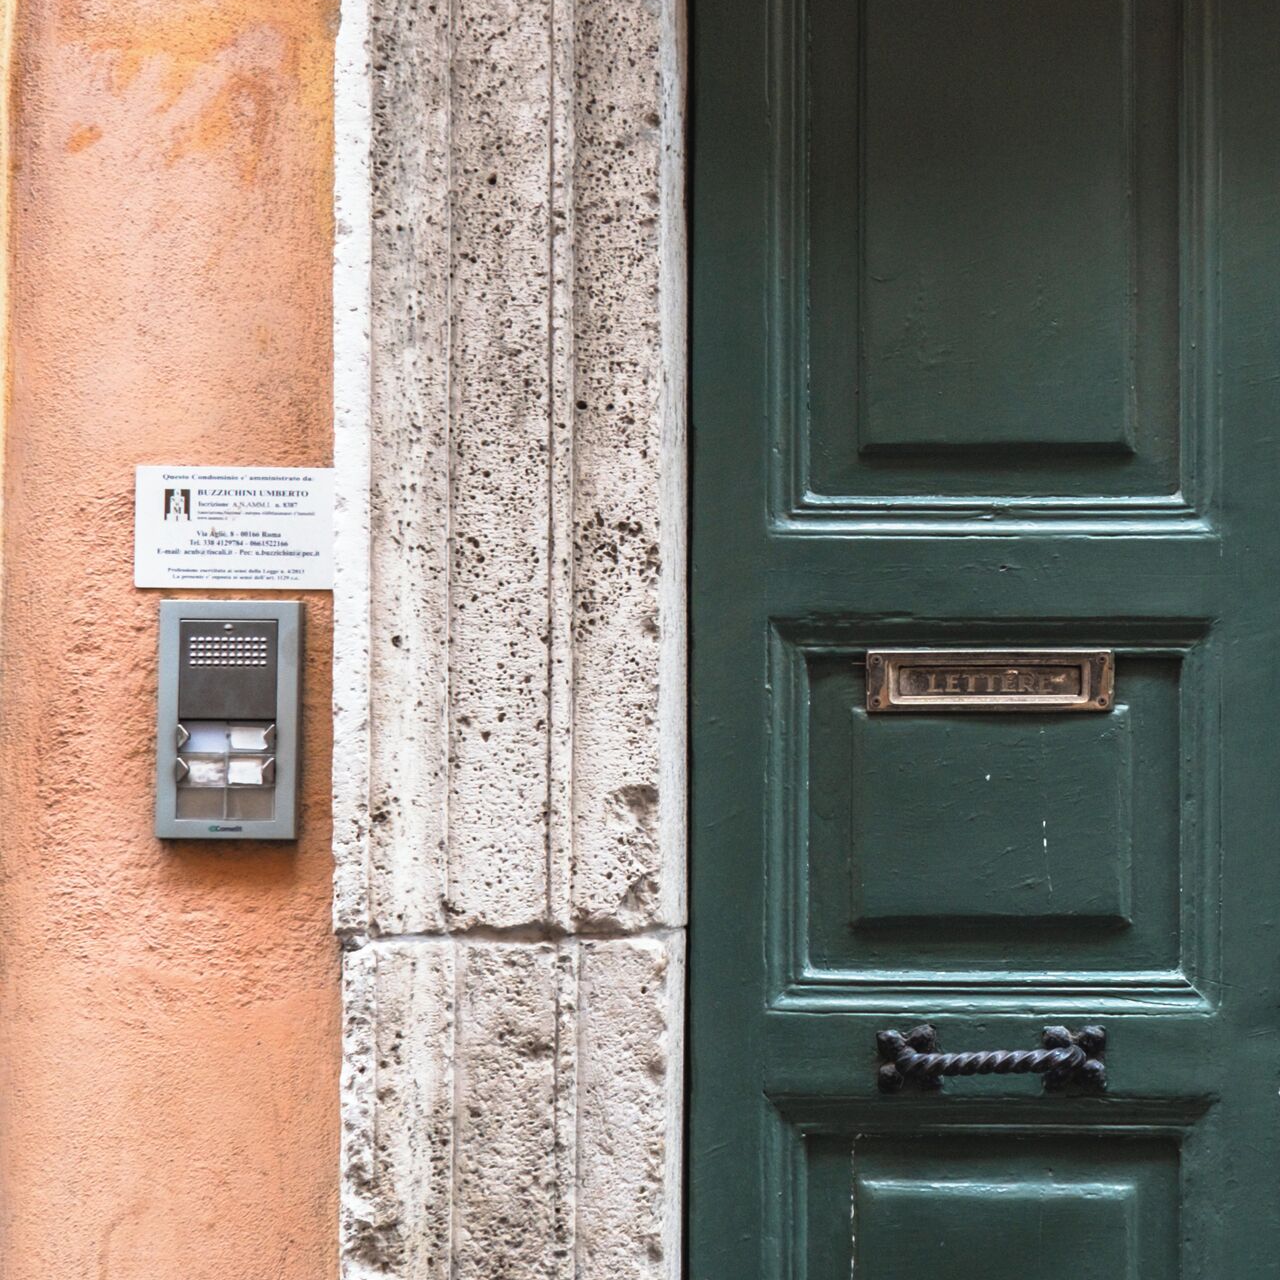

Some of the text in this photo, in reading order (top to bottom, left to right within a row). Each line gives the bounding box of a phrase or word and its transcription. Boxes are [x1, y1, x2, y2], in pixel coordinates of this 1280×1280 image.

[197, 489, 309, 498] BUZZICHINI UMBERTO
[926, 673, 1053, 693] LETTERE
